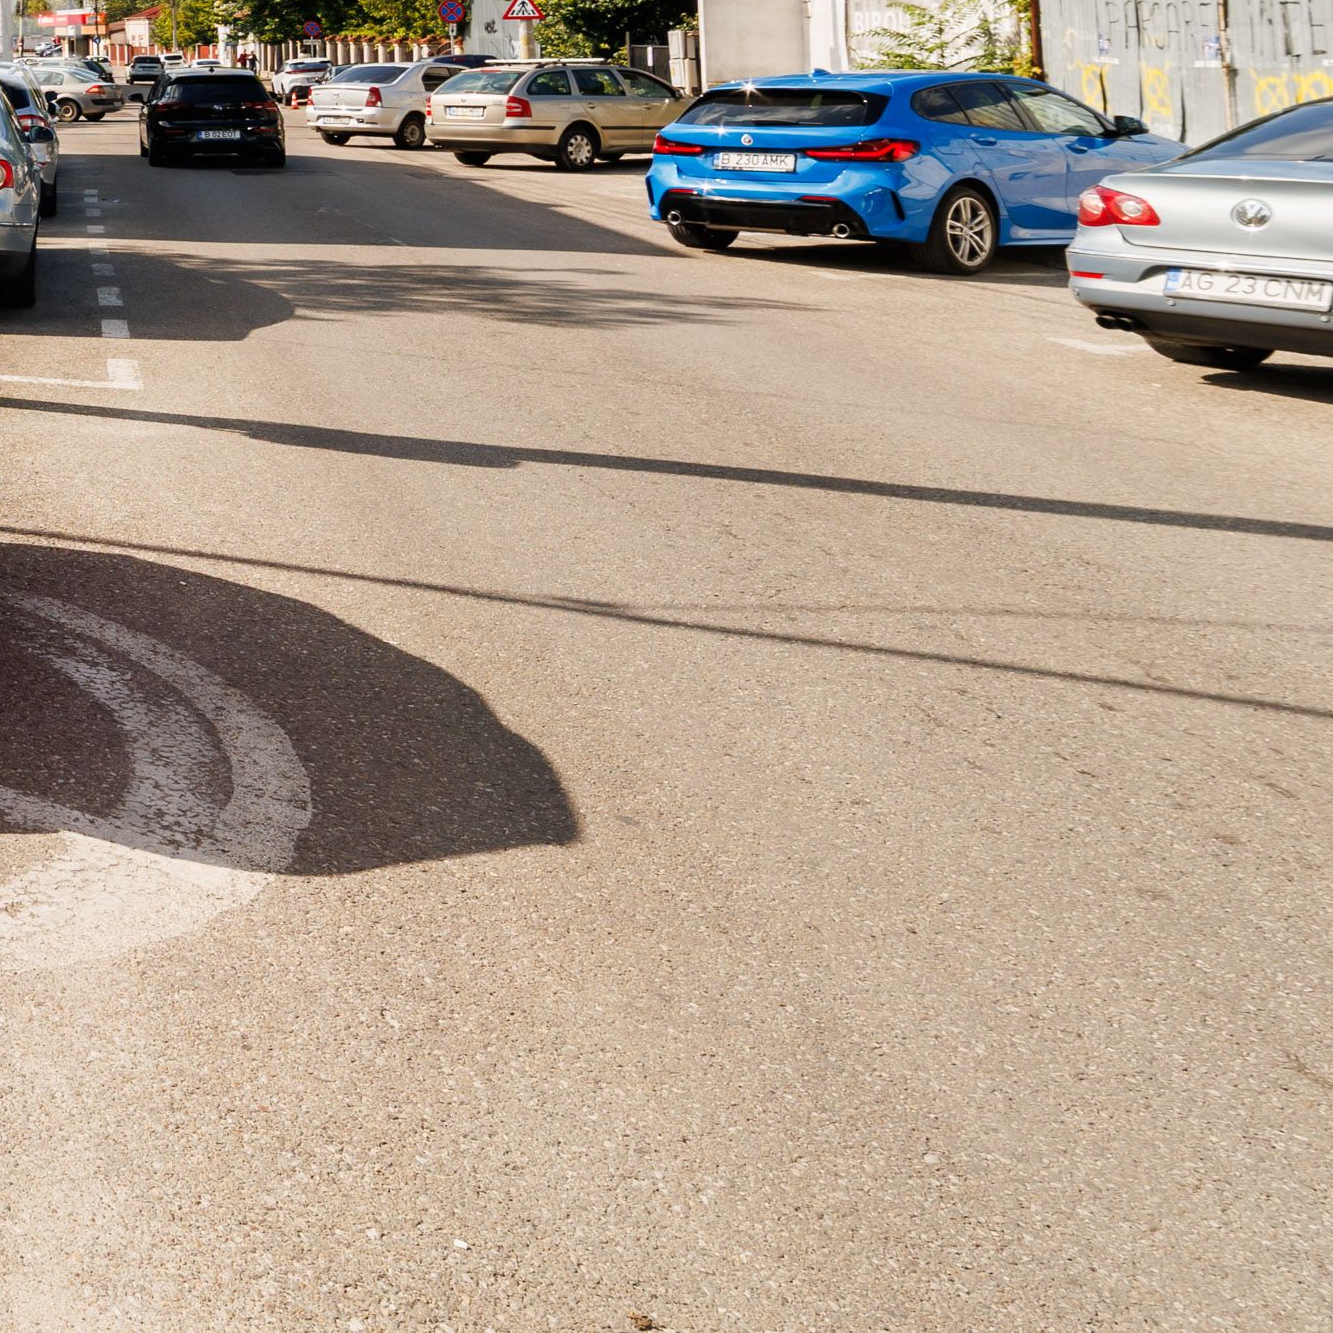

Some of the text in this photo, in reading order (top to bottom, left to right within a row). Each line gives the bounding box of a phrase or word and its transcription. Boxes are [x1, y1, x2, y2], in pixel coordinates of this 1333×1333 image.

[722, 153, 790, 167] B 230 AMK
[1180, 270, 1325, 302] AG 23 CNM
